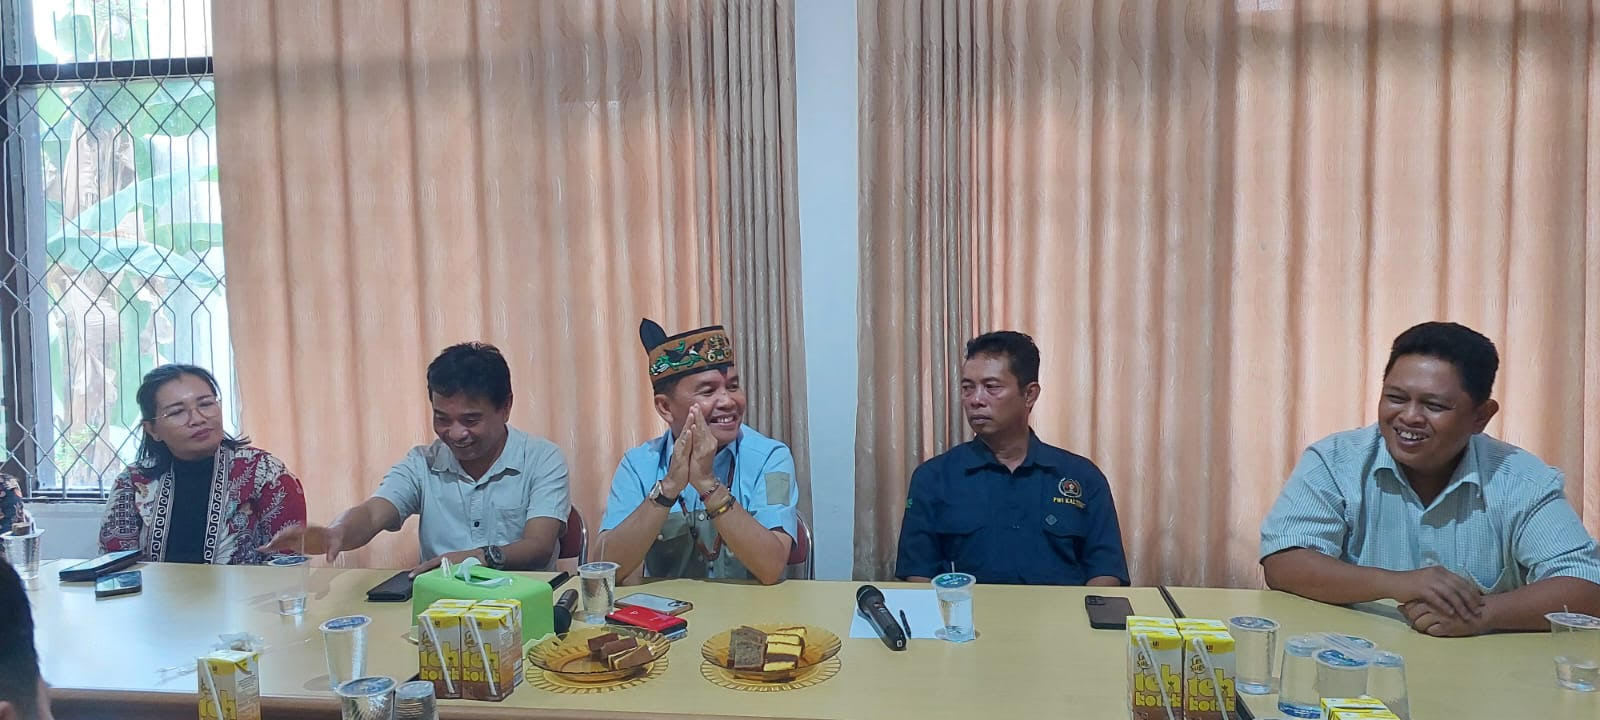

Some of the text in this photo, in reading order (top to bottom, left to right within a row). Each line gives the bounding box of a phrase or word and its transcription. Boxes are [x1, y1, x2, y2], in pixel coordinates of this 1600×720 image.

[420, 668, 460, 680] kotk
[1134, 664, 1181, 693] teh
[1187, 668, 1235, 698] teh
[1135, 692, 1181, 706] kotk
